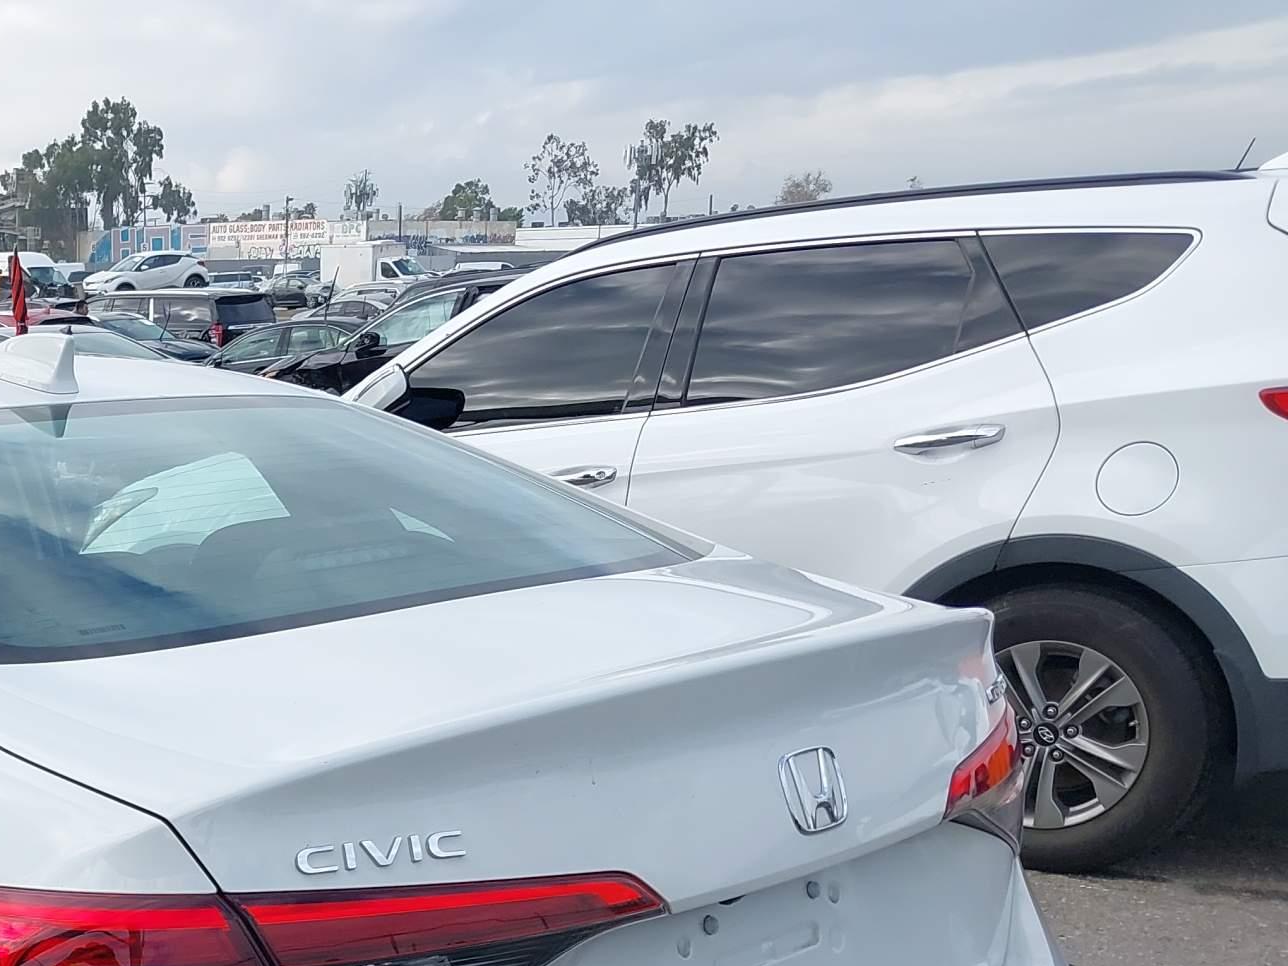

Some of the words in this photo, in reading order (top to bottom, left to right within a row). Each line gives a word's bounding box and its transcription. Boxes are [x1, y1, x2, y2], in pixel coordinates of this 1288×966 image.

[212, 225, 227, 233] AUTO
[290, 221, 325, 231] RADIATORS
[295, 830, 467, 875] CIVIC
